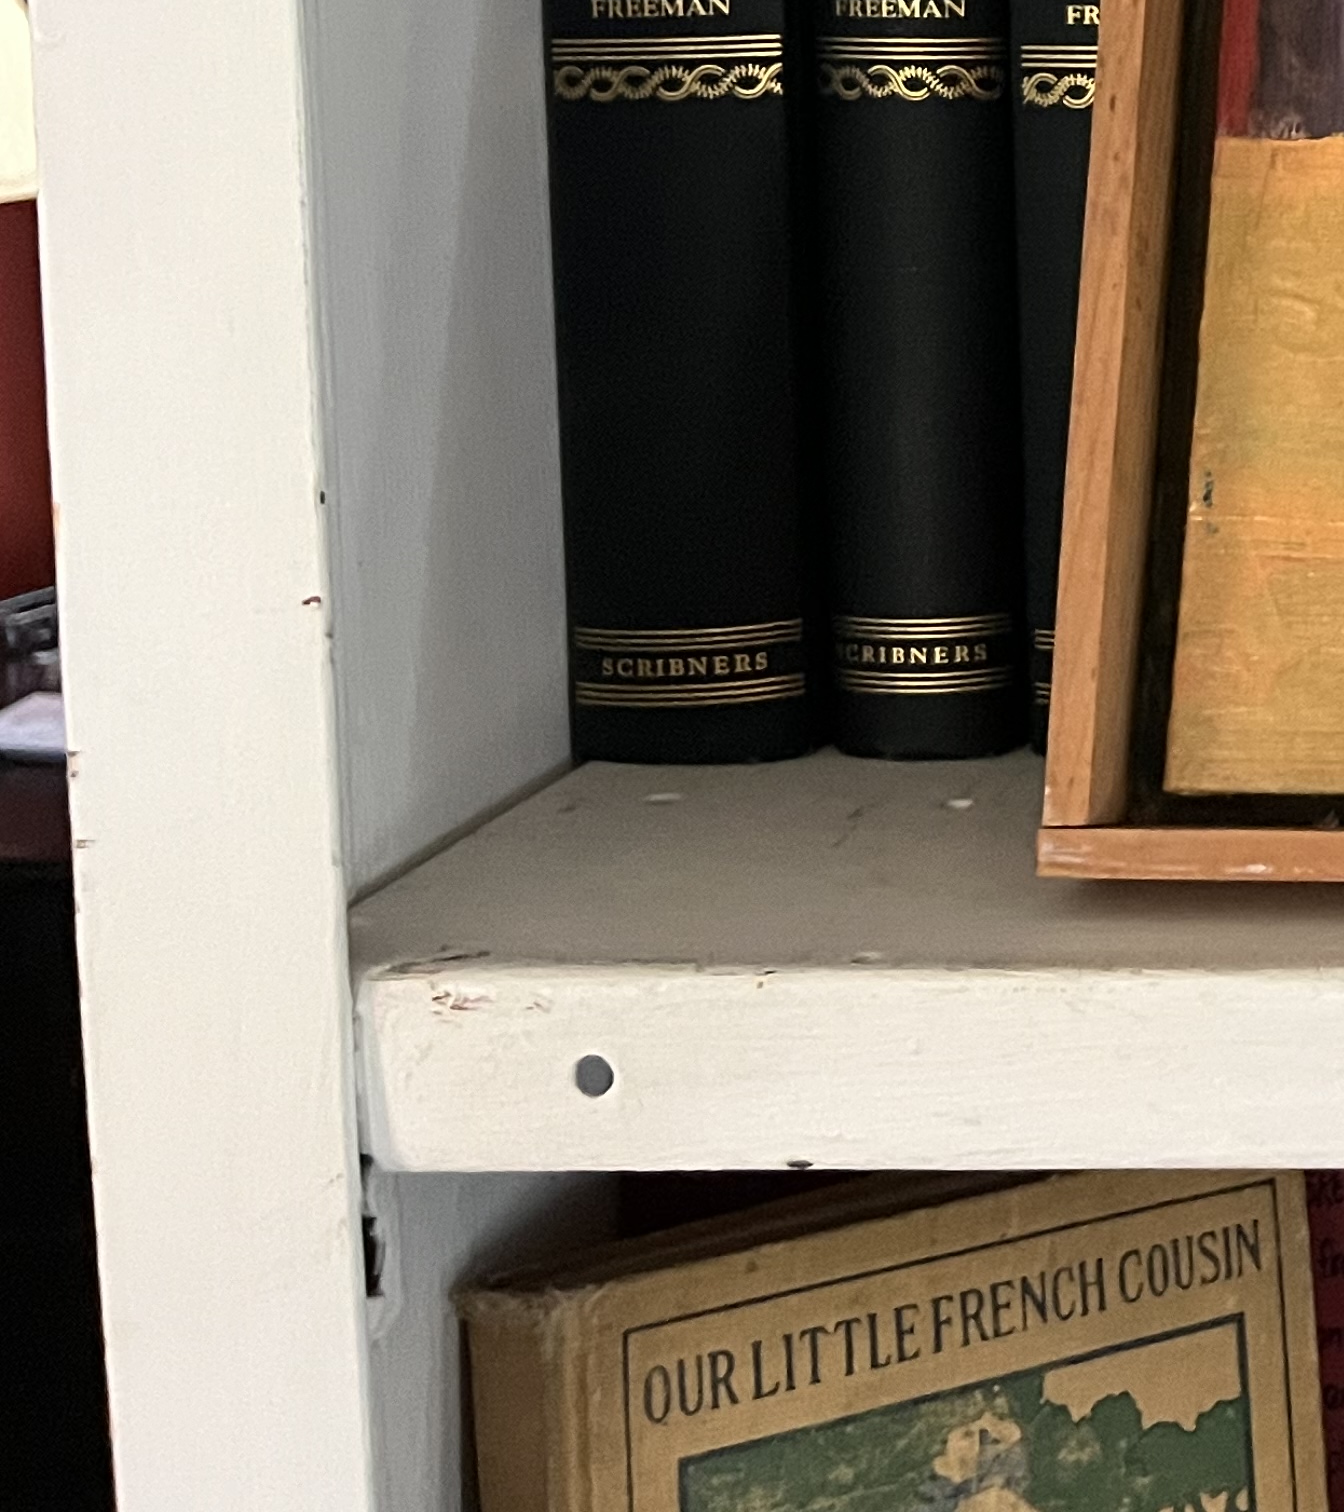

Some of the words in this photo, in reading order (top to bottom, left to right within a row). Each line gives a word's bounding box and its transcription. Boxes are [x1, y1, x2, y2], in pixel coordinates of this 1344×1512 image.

[601, 650, 769, 678] SCRIBNERS
[643, 1348, 740, 1424] OUR
[751, 1304, 920, 1399] LITTLE
[931, 1257, 1109, 1354] FRENCH
[1117, 1218, 1263, 1305] COUSIN
